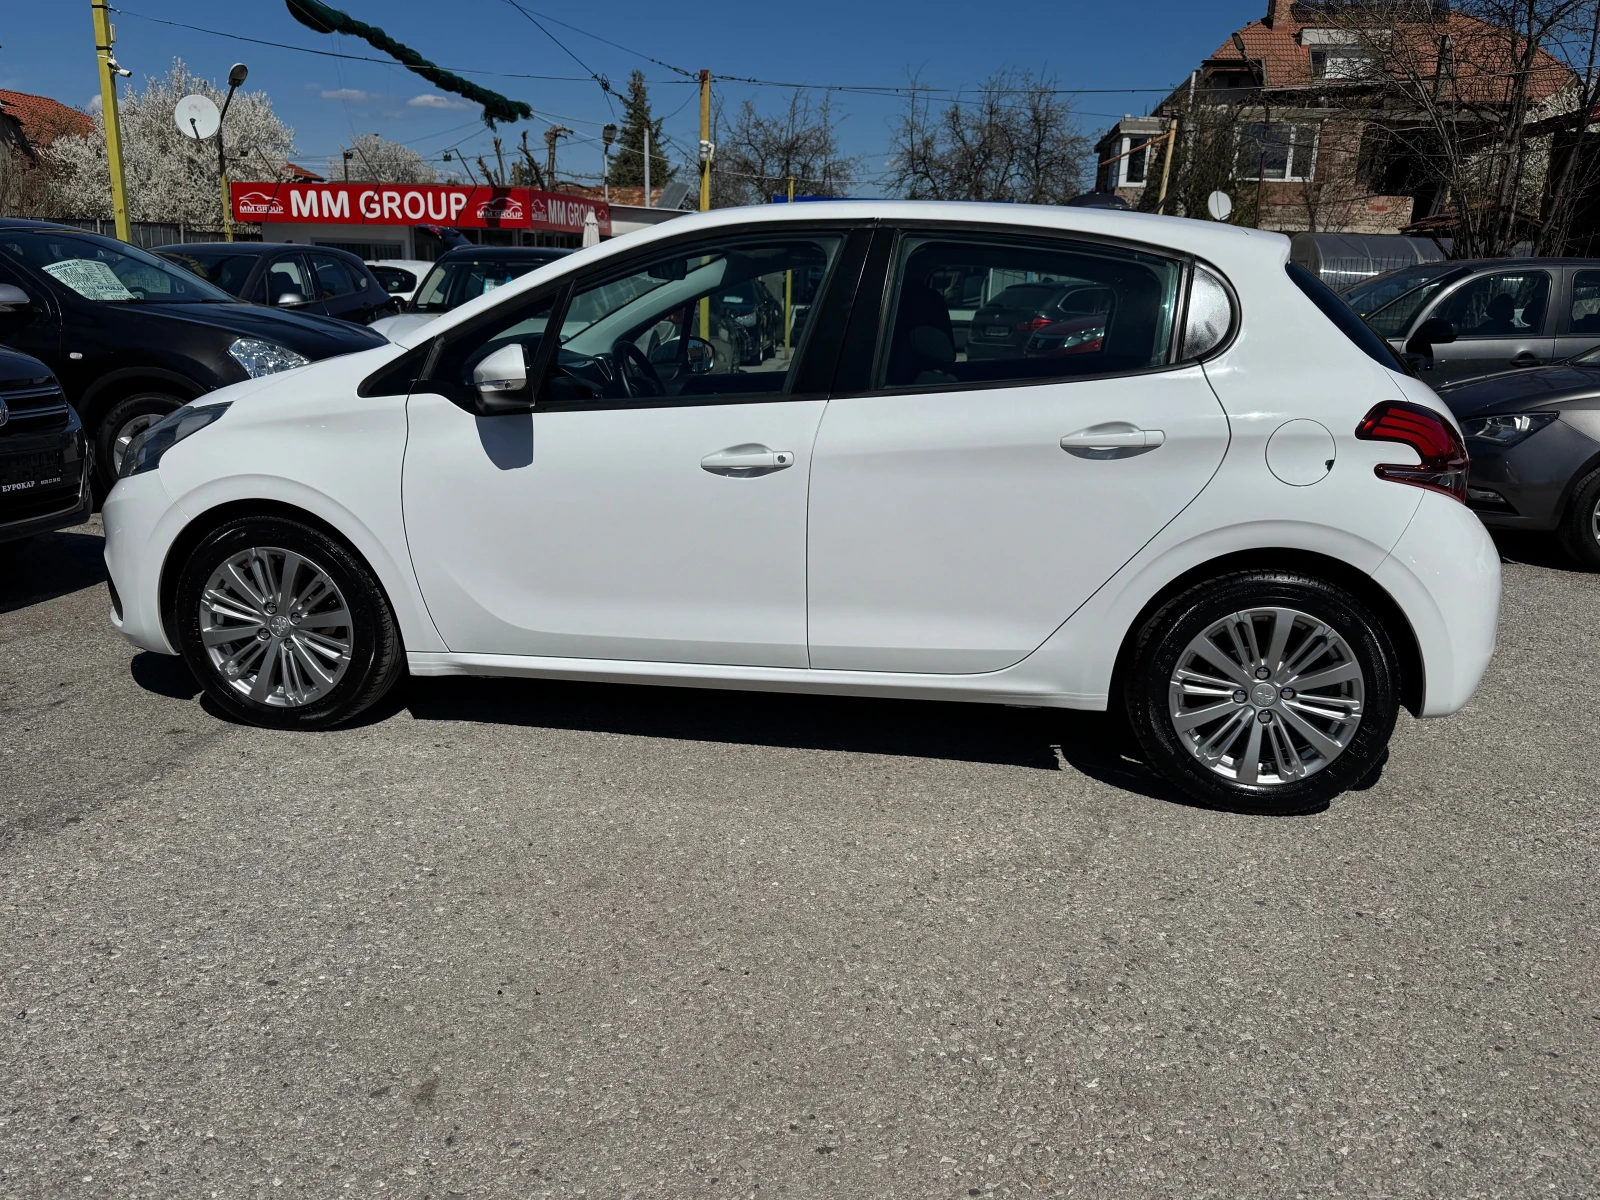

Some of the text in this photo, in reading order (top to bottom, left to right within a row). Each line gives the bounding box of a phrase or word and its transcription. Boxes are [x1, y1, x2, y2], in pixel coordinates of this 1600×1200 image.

[290, 190, 467, 221] MM GROUP
[477, 210, 523, 219] MM GROUP
[547, 199, 566, 226] MM
[2, 480, 35, 493] ЕУРОКАР
